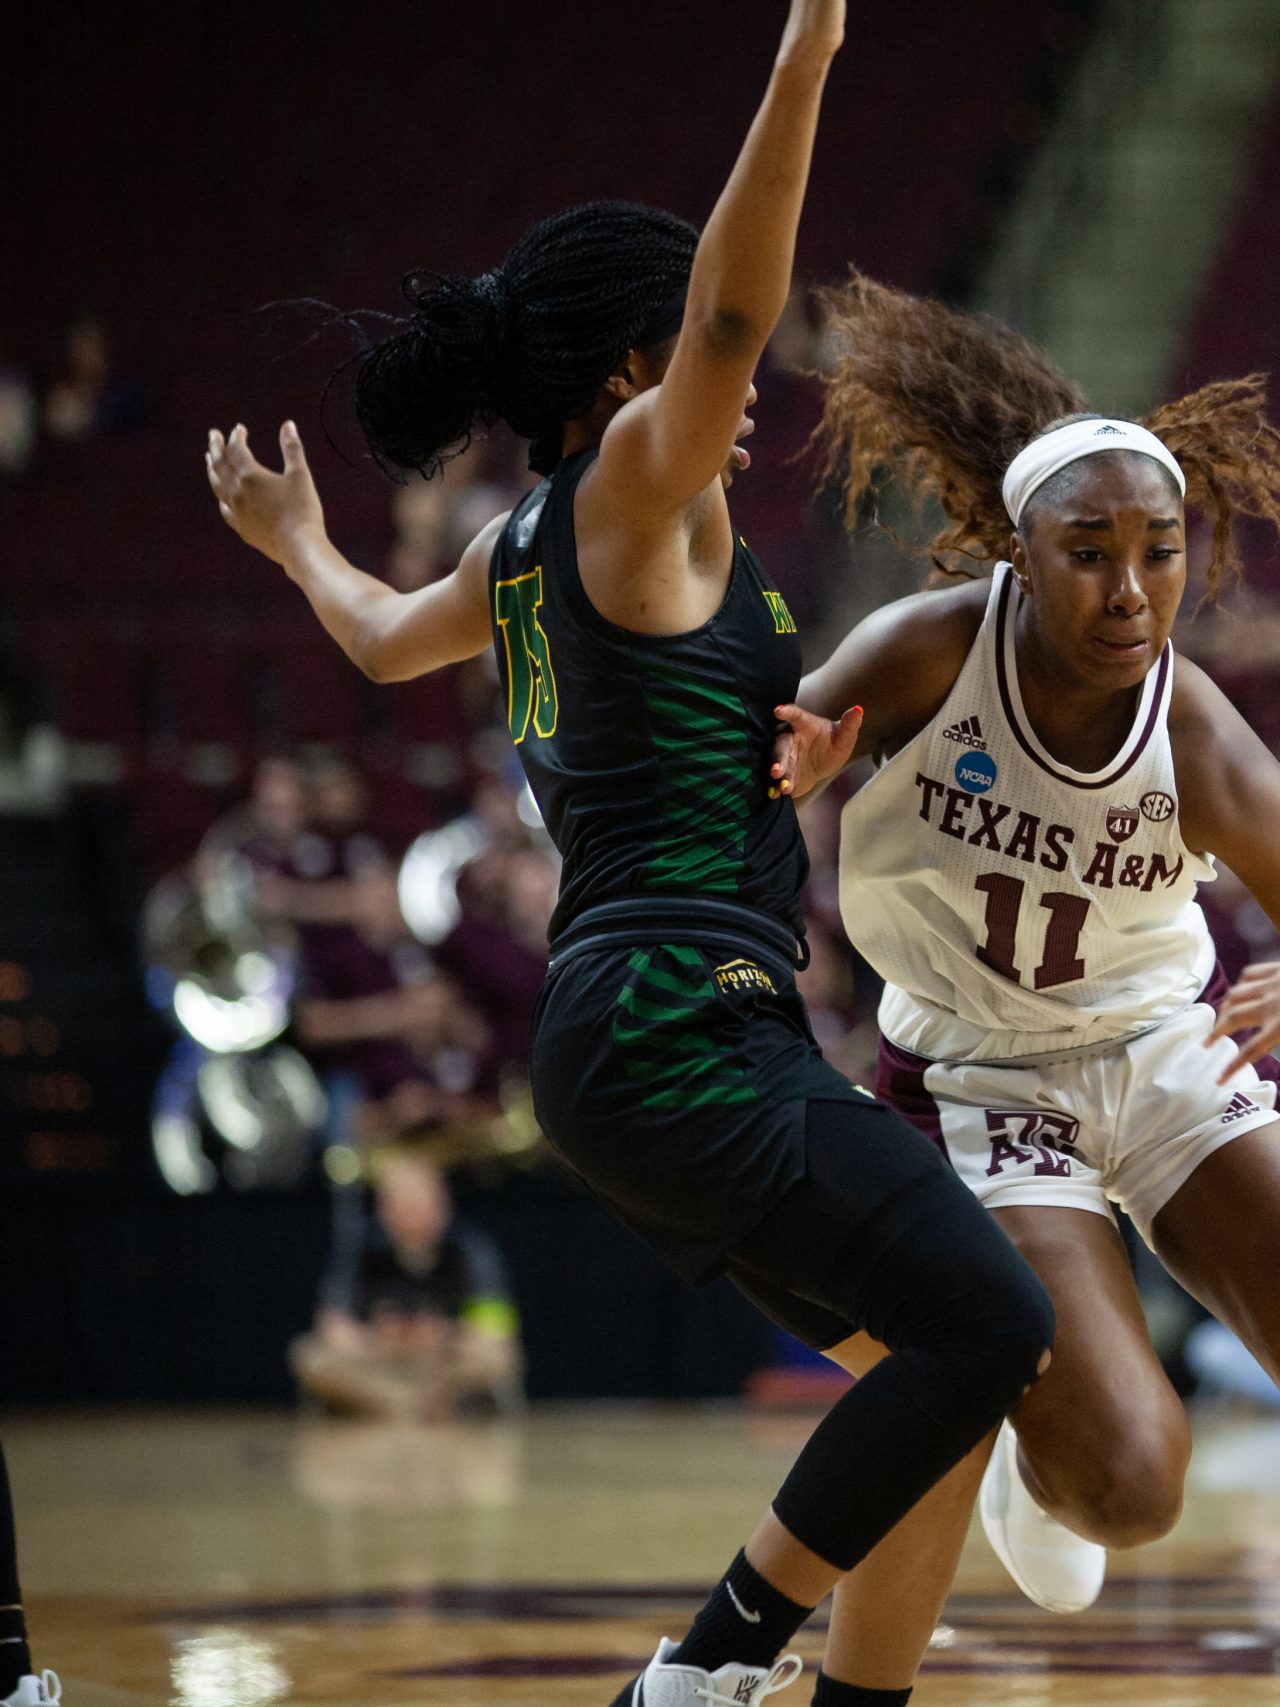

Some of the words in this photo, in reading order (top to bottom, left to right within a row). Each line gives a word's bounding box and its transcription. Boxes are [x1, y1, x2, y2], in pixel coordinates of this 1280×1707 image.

[942, 729, 988, 751] adidas
[959, 767, 993, 788] NCAA
[1142, 791, 1173, 821] SEC
[915, 772, 1076, 874] TEXAS
[1081, 840, 1184, 893] A&M
[1109, 818, 1131, 835] 41
[974, 871, 1091, 991] 11
